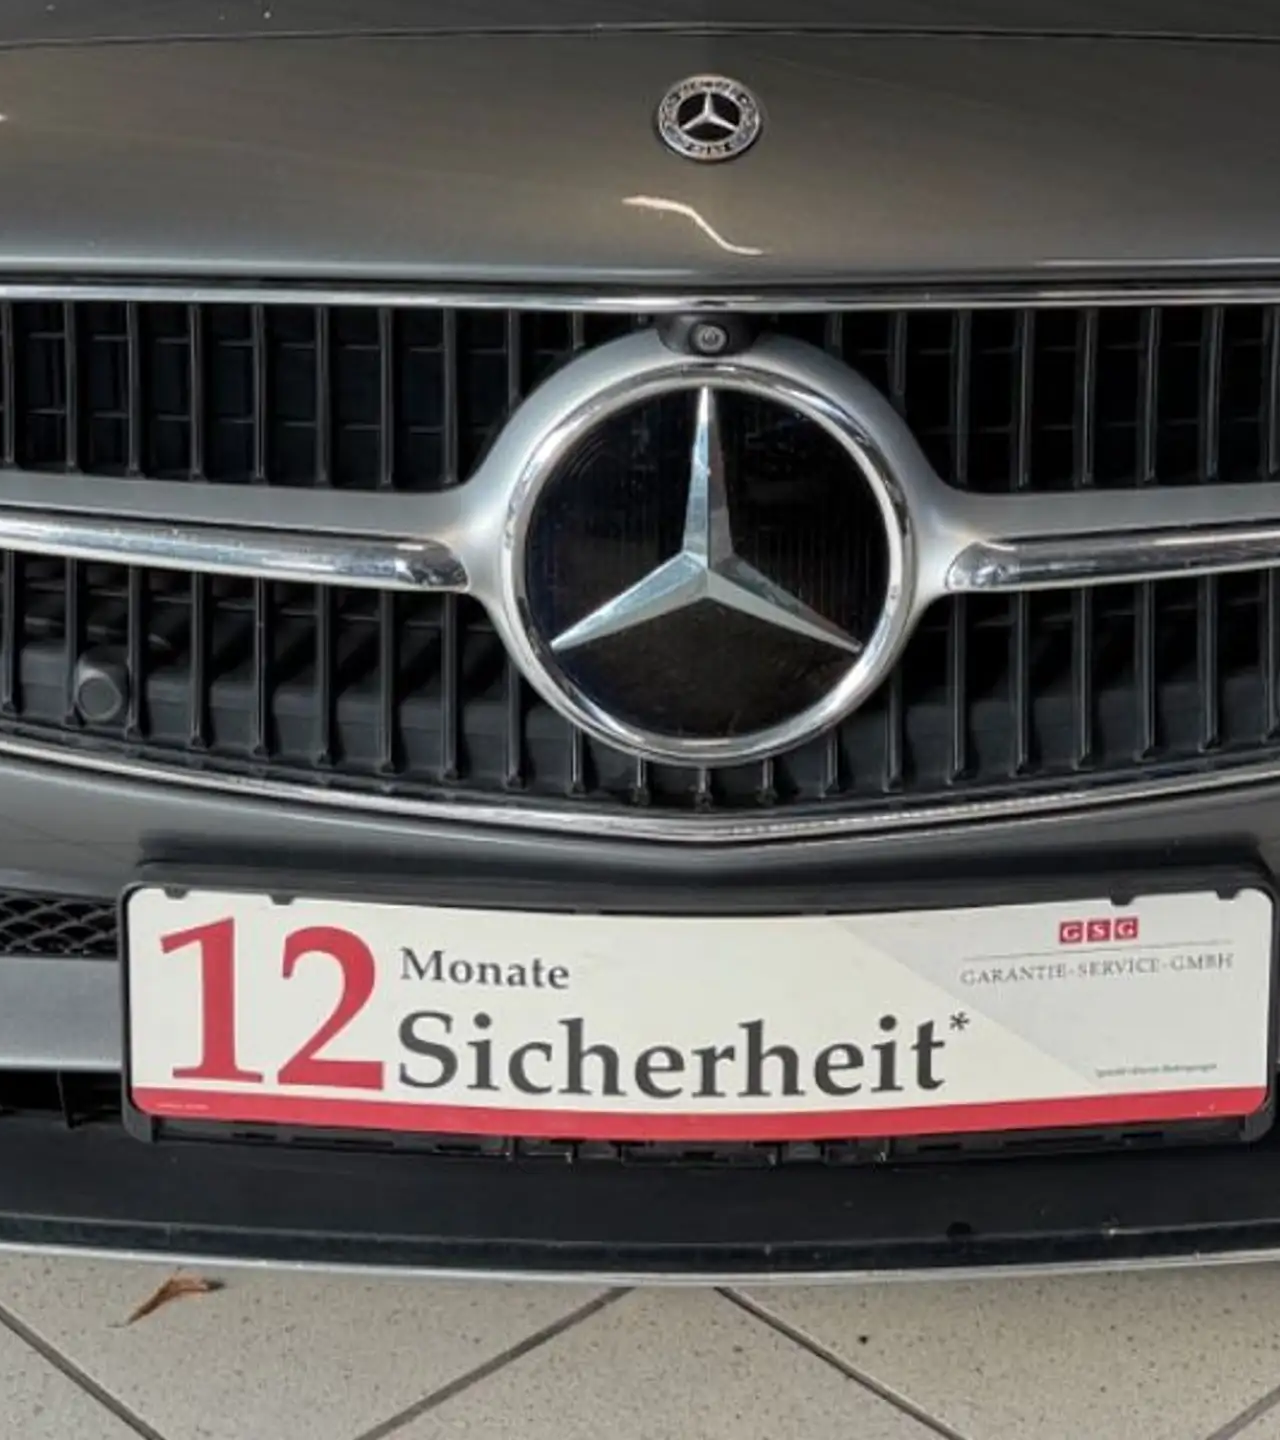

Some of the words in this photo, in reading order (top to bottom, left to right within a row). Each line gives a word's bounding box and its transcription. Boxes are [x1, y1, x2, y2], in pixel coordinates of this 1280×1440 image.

[1060, 918, 1138, 944] GSG
[399, 946, 570, 990] Monate
[160, 916, 384, 1089] 12
